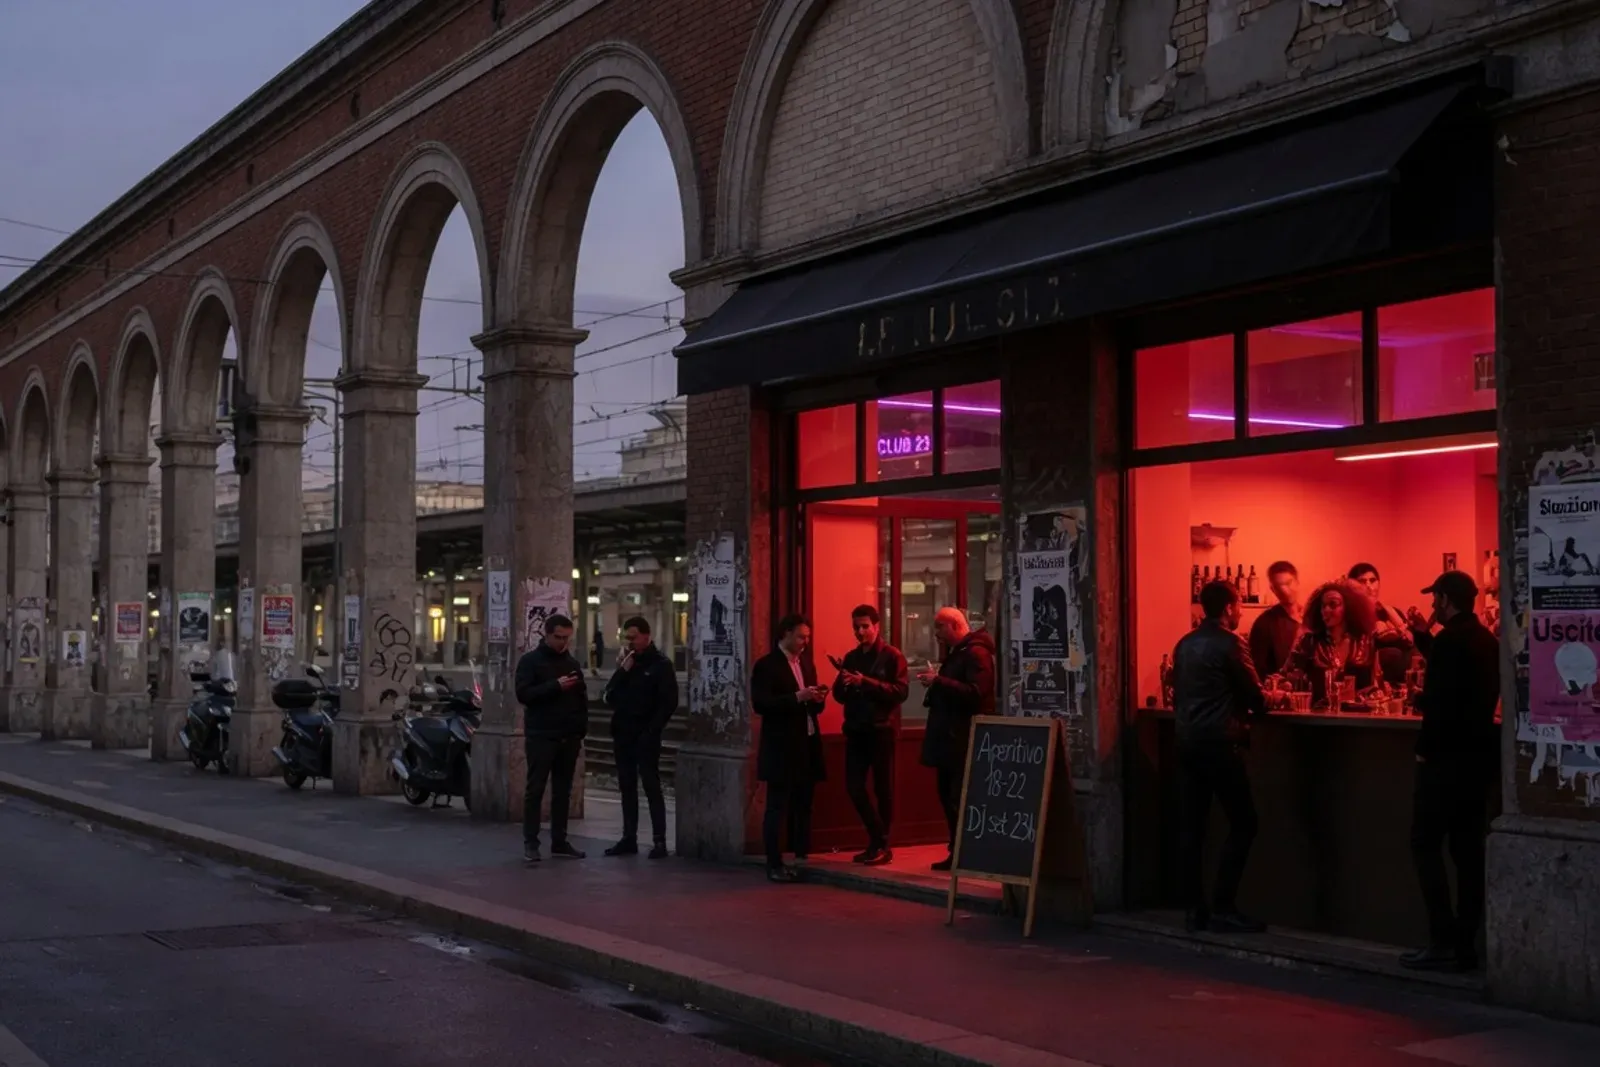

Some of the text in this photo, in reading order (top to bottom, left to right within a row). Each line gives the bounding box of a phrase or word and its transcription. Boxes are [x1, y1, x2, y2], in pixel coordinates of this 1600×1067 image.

[877, 435, 931, 456] CLUB 23
[977, 732, 1044, 770] Aperitivo
[985, 770, 1026, 799] 18-22
[988, 811, 1009, 836] set
